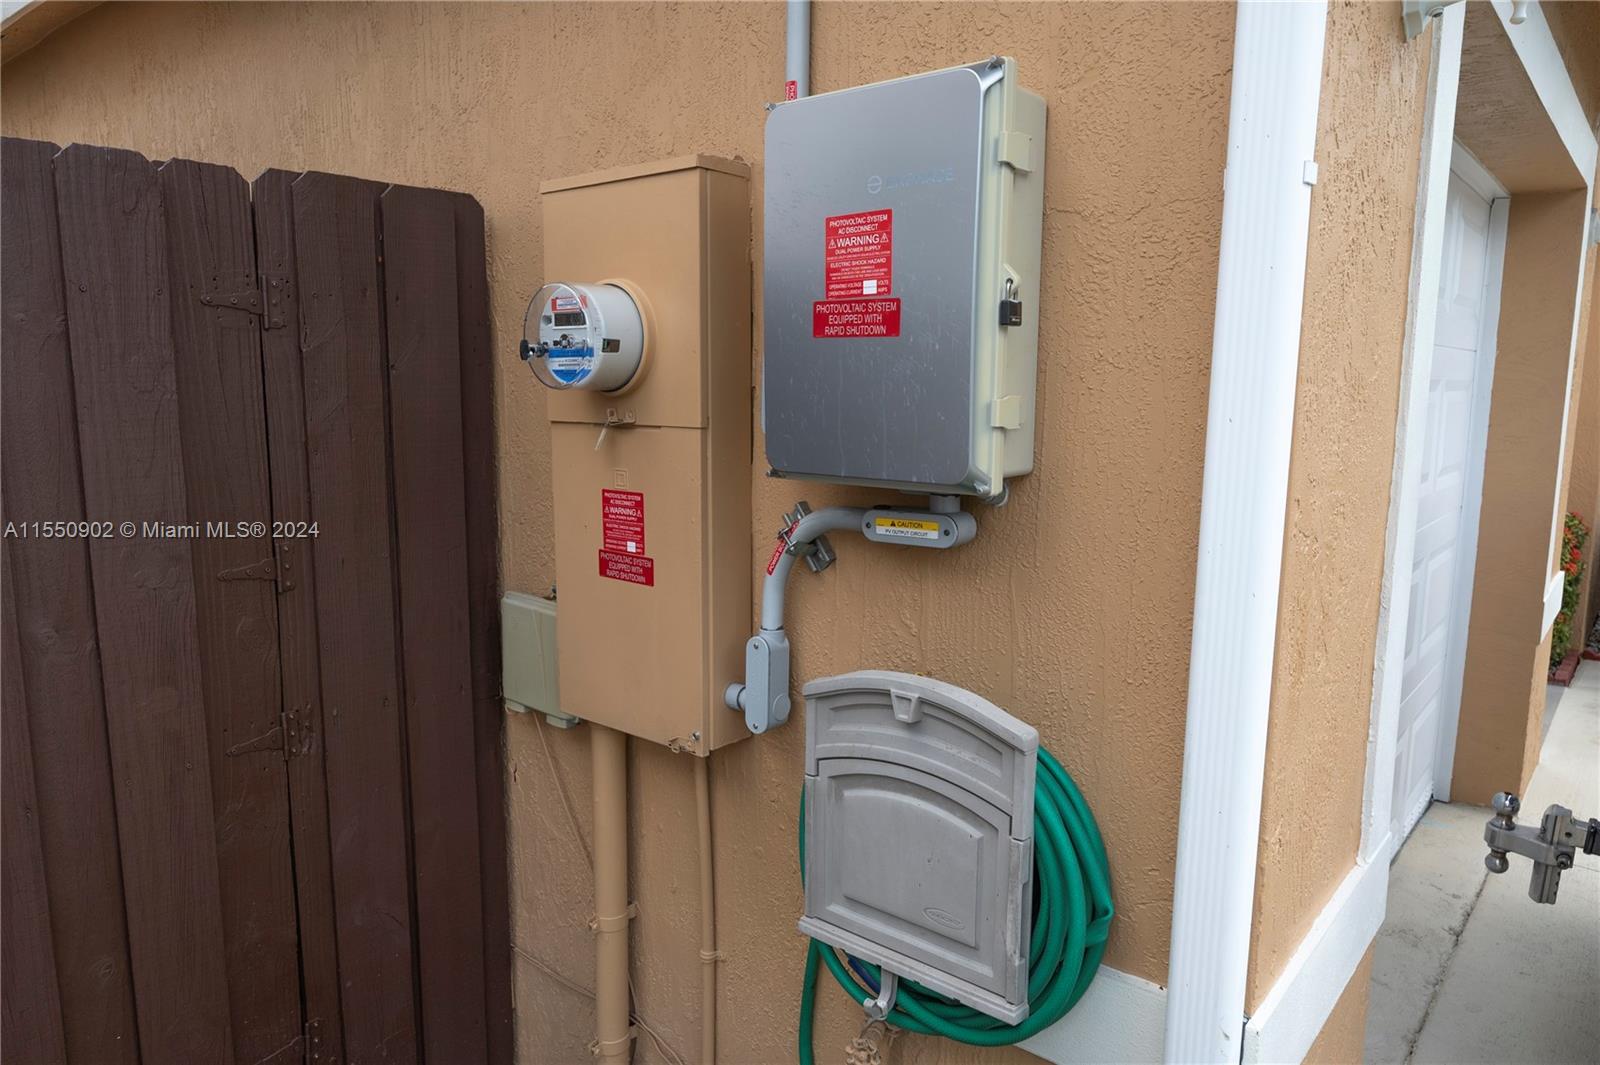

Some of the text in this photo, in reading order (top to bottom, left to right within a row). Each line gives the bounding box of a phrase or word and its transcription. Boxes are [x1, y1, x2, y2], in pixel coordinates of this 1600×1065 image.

[829, 214, 888, 228] PHOTOVOLTAIC SYSTEM
[846, 223, 878, 234] DISCONNECT
[836, 234, 879, 247] WARNING
[816, 302, 897, 314] PHOTOVOLTAIC SYSTEM
[828, 315, 862, 324] EQUIPPED
[824, 325, 886, 336] RAPID SHUTDOWN
[609, 507, 637, 516] WARNING
[897, 521, 923, 529] CAUTION
[600, 552, 652, 568] PHOTOVOLTAIC SYSTEM
[608, 562, 631, 571] EQUIPPED
[606, 570, 646, 583] RAPID SHUTDOWN
